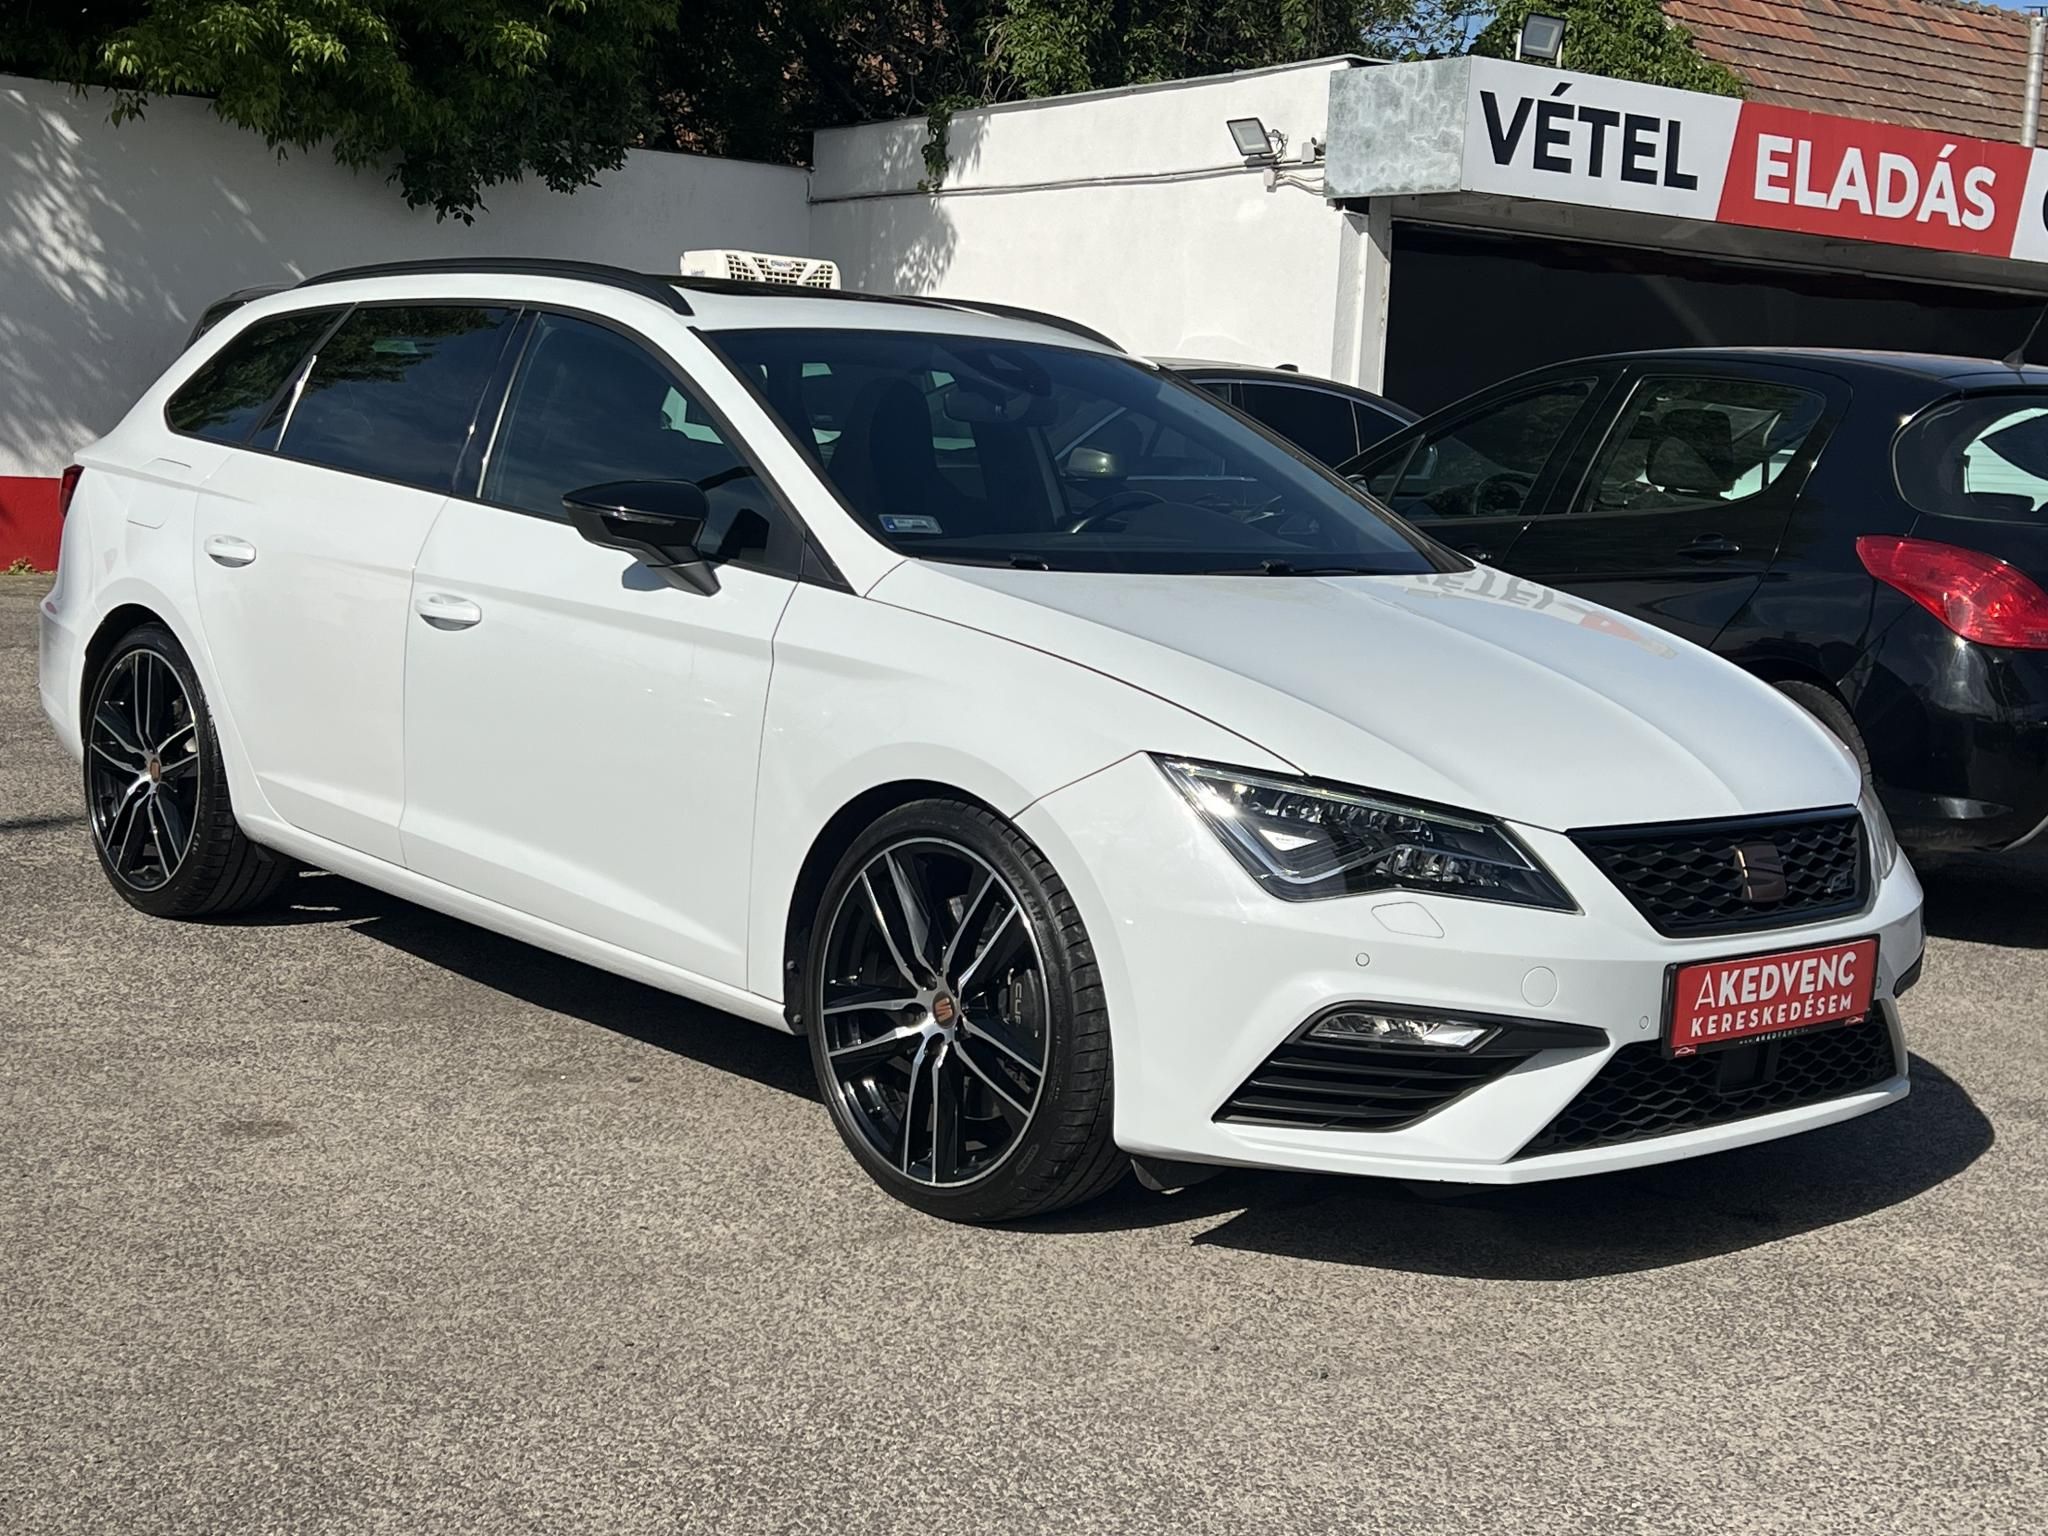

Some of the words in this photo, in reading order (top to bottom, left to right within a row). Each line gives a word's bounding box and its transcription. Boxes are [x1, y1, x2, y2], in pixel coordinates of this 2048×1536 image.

[1480, 82, 1698, 191] VÉTEL
[1754, 133, 1996, 231] ELADÁS
[1690, 992, 1853, 1038] KERESKEDÉSEM
